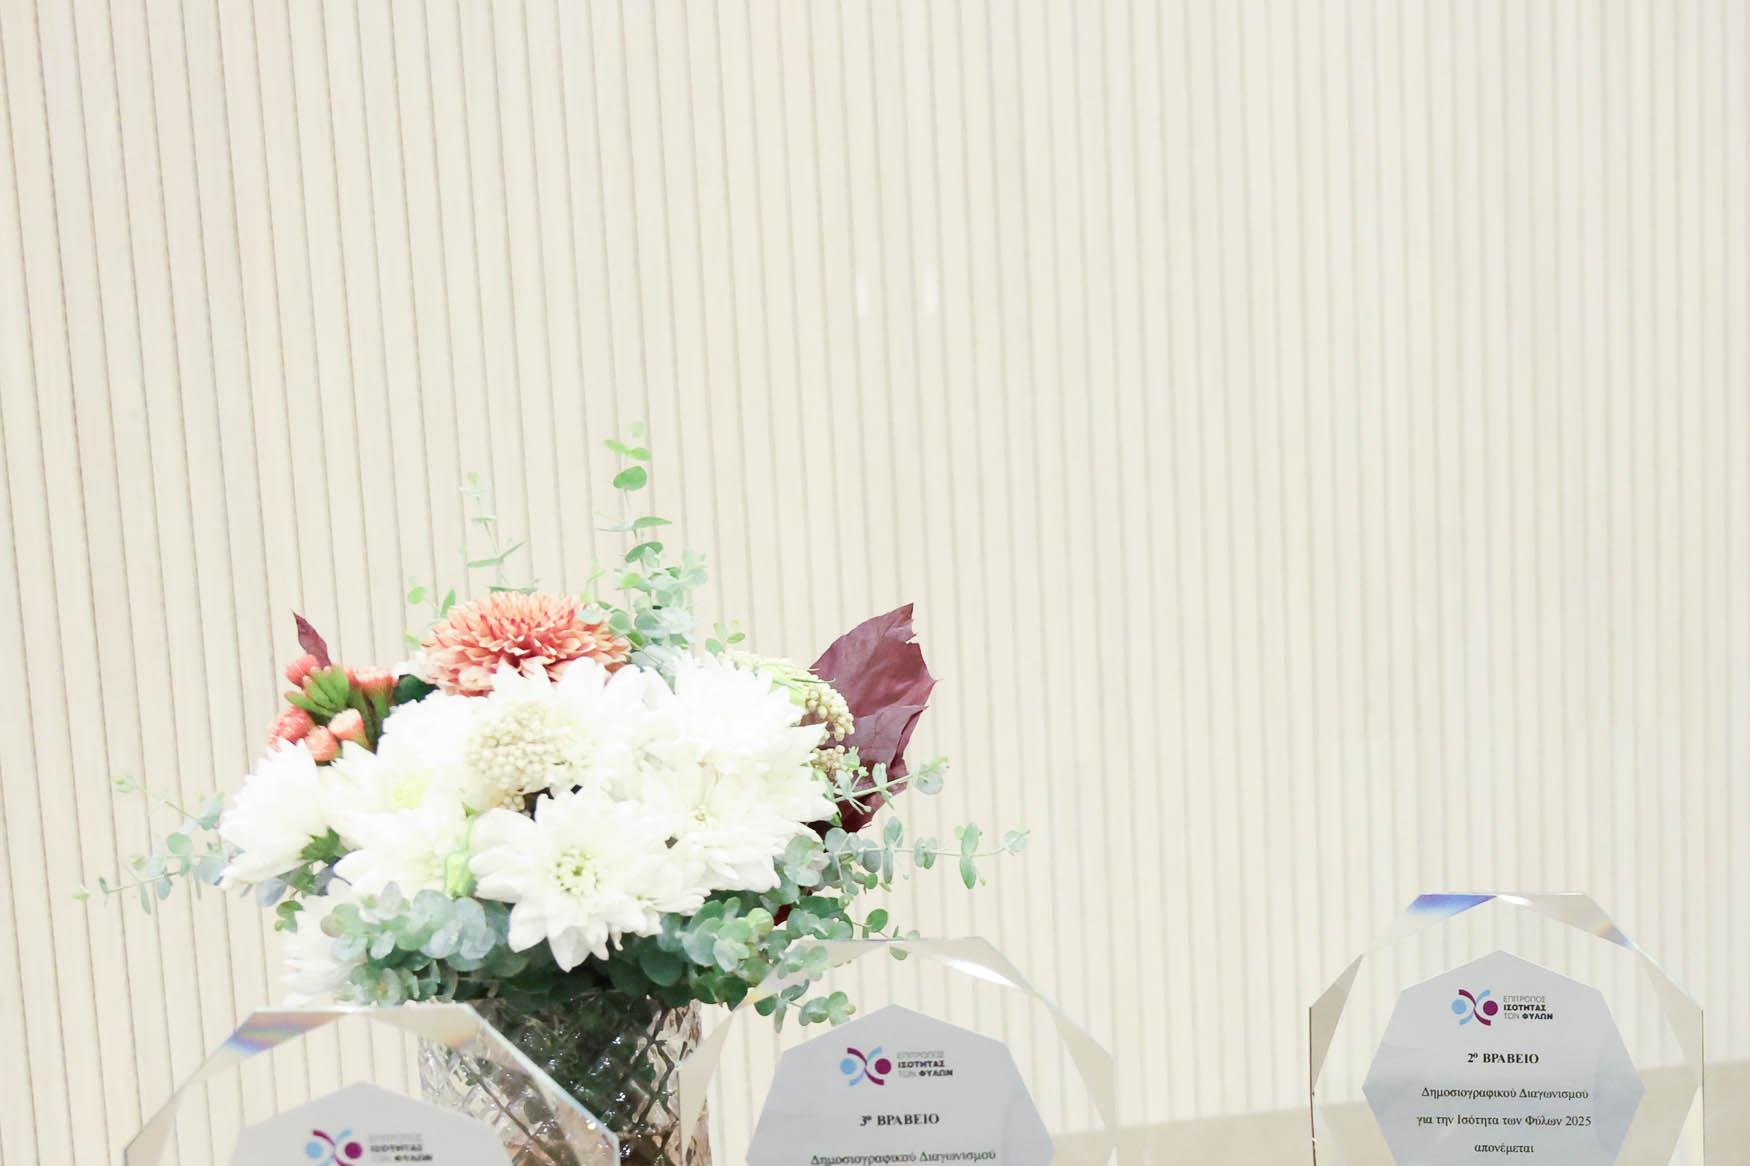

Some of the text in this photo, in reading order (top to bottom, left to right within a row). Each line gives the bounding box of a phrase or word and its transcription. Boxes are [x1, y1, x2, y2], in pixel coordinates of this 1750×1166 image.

[1482, 1052, 1540, 1064] ΒΡΑΒΕΙΟ
[1421, 1087, 1589, 1101] Δημοσιογραφικού Διαγωνισμού
[877, 1113, 940, 1126] ΒΡΑΒΕΙΟ
[1416, 1114, 1592, 1128] για την Ισότητα των Φύλων 2025
[1474, 1142, 1534, 1156] απονέμεται
[919, 1150, 997, 1164] Διαγωνισμού
